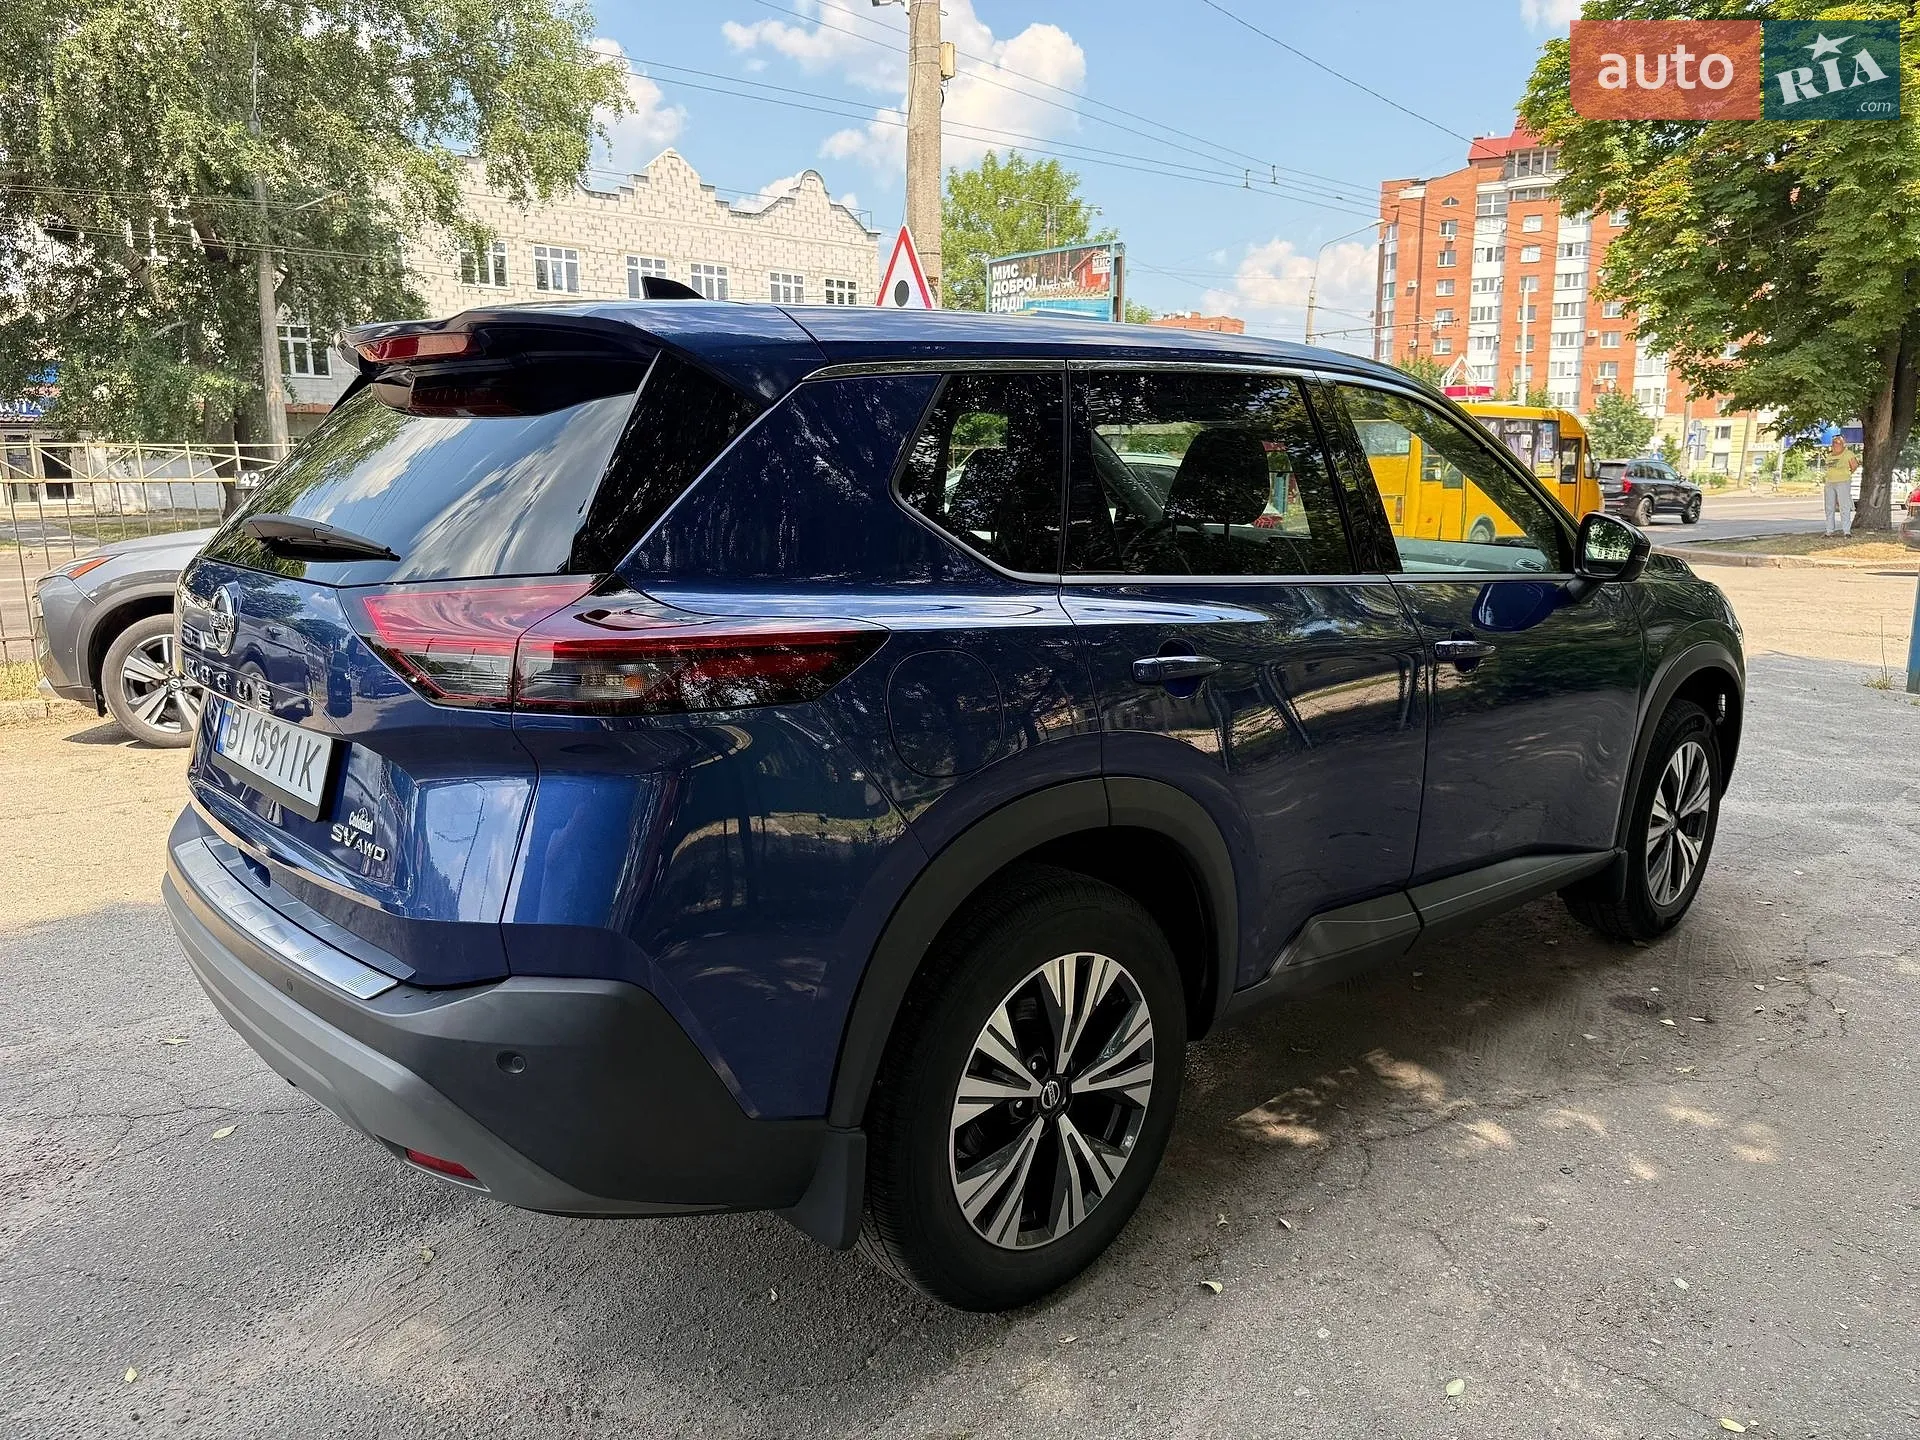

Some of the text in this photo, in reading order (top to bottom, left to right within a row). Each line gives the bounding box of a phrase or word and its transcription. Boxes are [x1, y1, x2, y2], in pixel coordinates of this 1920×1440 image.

[991, 273, 1038, 298] ДОБРОЇ
[992, 263, 1019, 280] МИС
[991, 291, 1026, 313] НАДІЇ
[185, 657, 273, 711] ROGUE
[251, 717, 291, 777] 1591
[288, 735, 322, 793] IK
[330, 823, 387, 862] SV AWD
